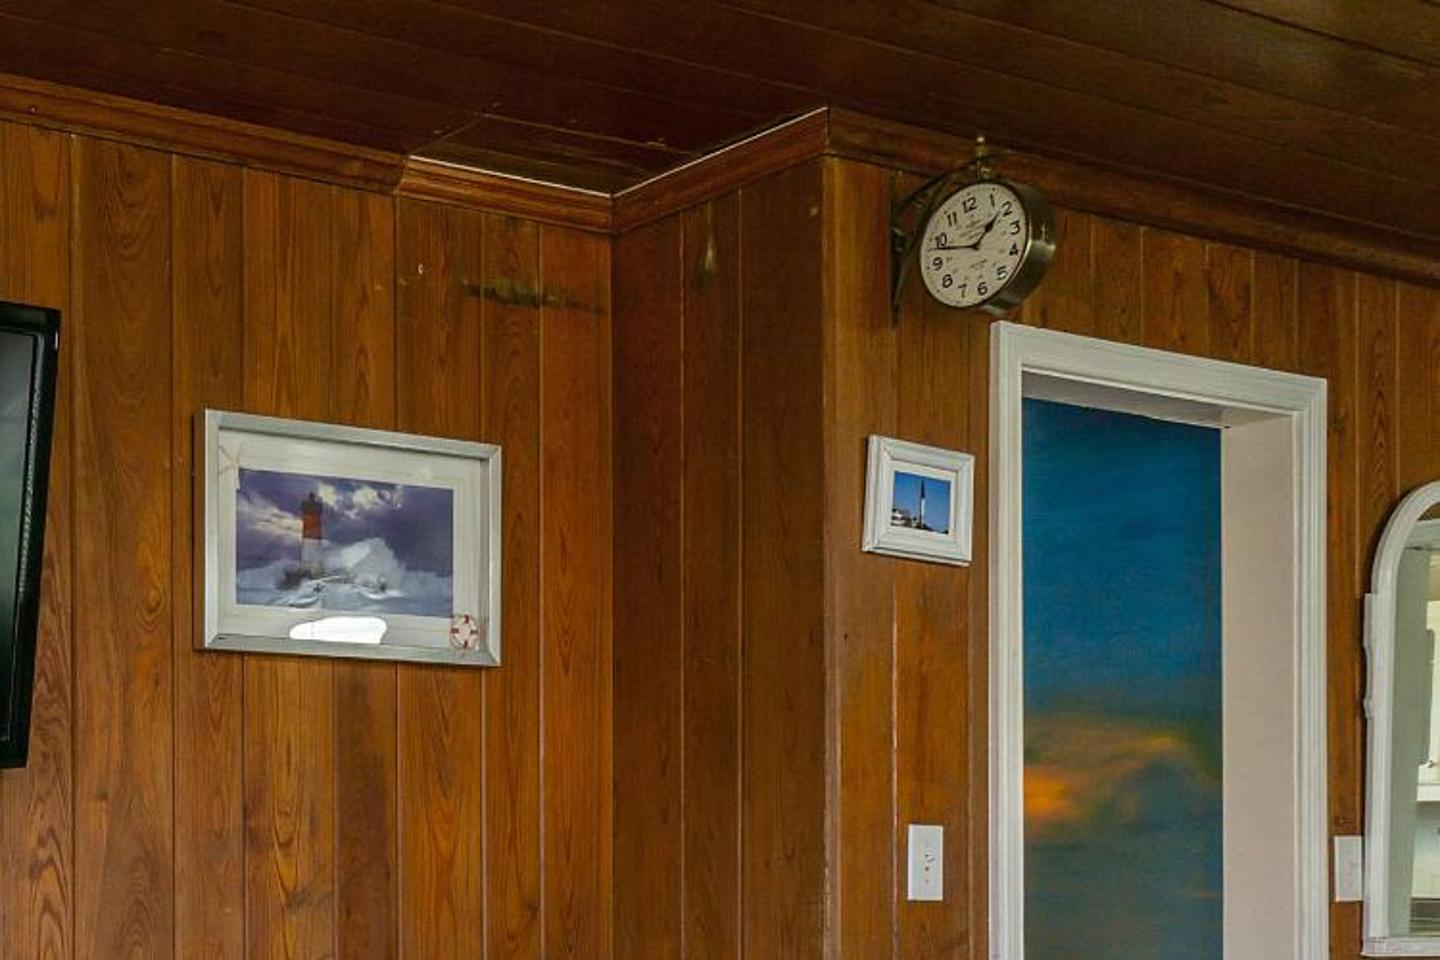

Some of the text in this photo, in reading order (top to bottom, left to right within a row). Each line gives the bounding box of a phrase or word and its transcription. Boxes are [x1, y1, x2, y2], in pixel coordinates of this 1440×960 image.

[962, 197, 977, 213] 12
[1001, 201, 1013, 217] 2
[947, 211, 958, 228] 11
[1009, 220, 1020, 235] 3
[934, 232, 948, 249] 10
[1009, 242, 1019, 256] 4
[932, 256, 943, 271] 9
[996, 265, 1008, 280] 5
[942, 273, 954, 288] 8
[958, 283, 967, 298] 7
[977, 281, 988, 296] 6
